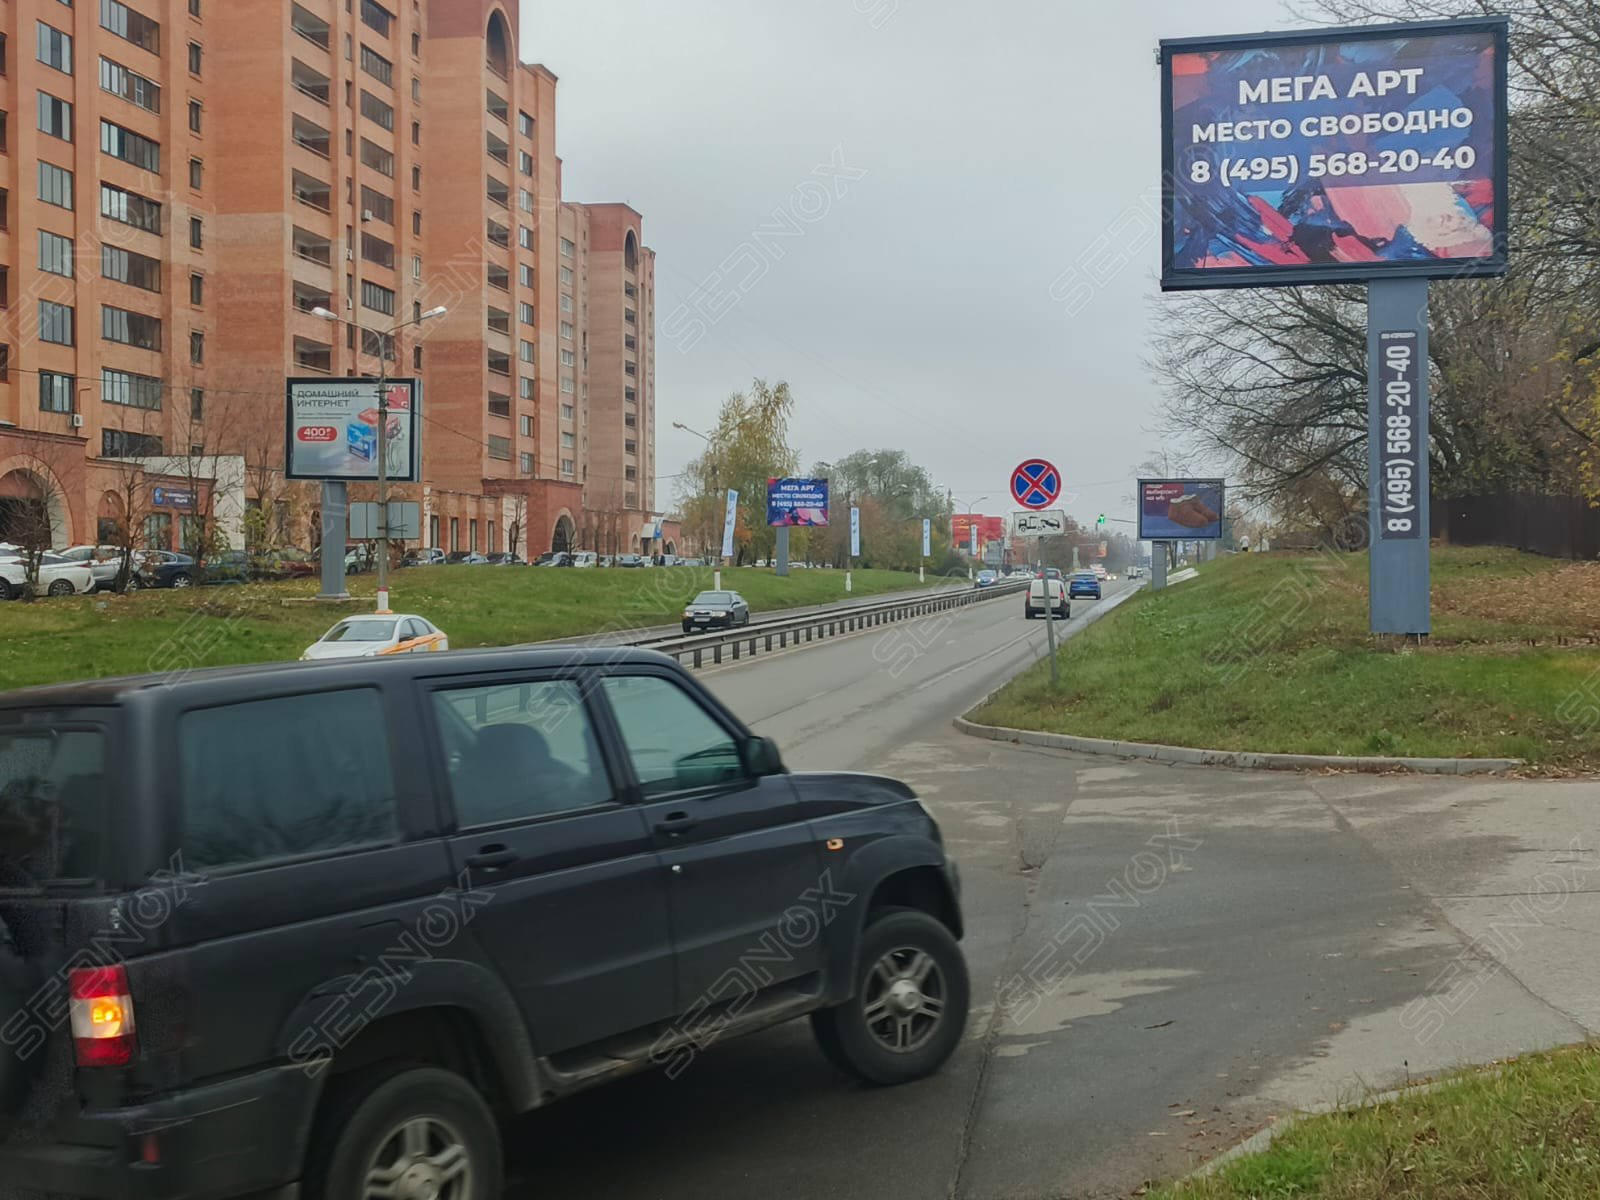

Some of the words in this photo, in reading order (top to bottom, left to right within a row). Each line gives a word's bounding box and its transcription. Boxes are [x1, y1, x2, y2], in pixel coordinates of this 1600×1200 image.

[1238, 74, 1338, 105] МЕГА
[1347, 68, 1424, 98] АРТ
[1192, 118, 1292, 144] МЕСТО
[1299, 107, 1474, 138] СВОБОДНО
[1190, 160, 1211, 184] 8
[1220, 154, 1299, 187] (495)
[1307, 145, 1476, 178] 568-20-40
[297, 388, 359, 399] ДОМАШНИЙ
[297, 399, 350, 408] ИНТЕРНЕТ
[1386, 345, 1412, 454] 568-20-40
[1385, 458, 1415, 513] (495)
[1387, 518, 1412, 532] 8
